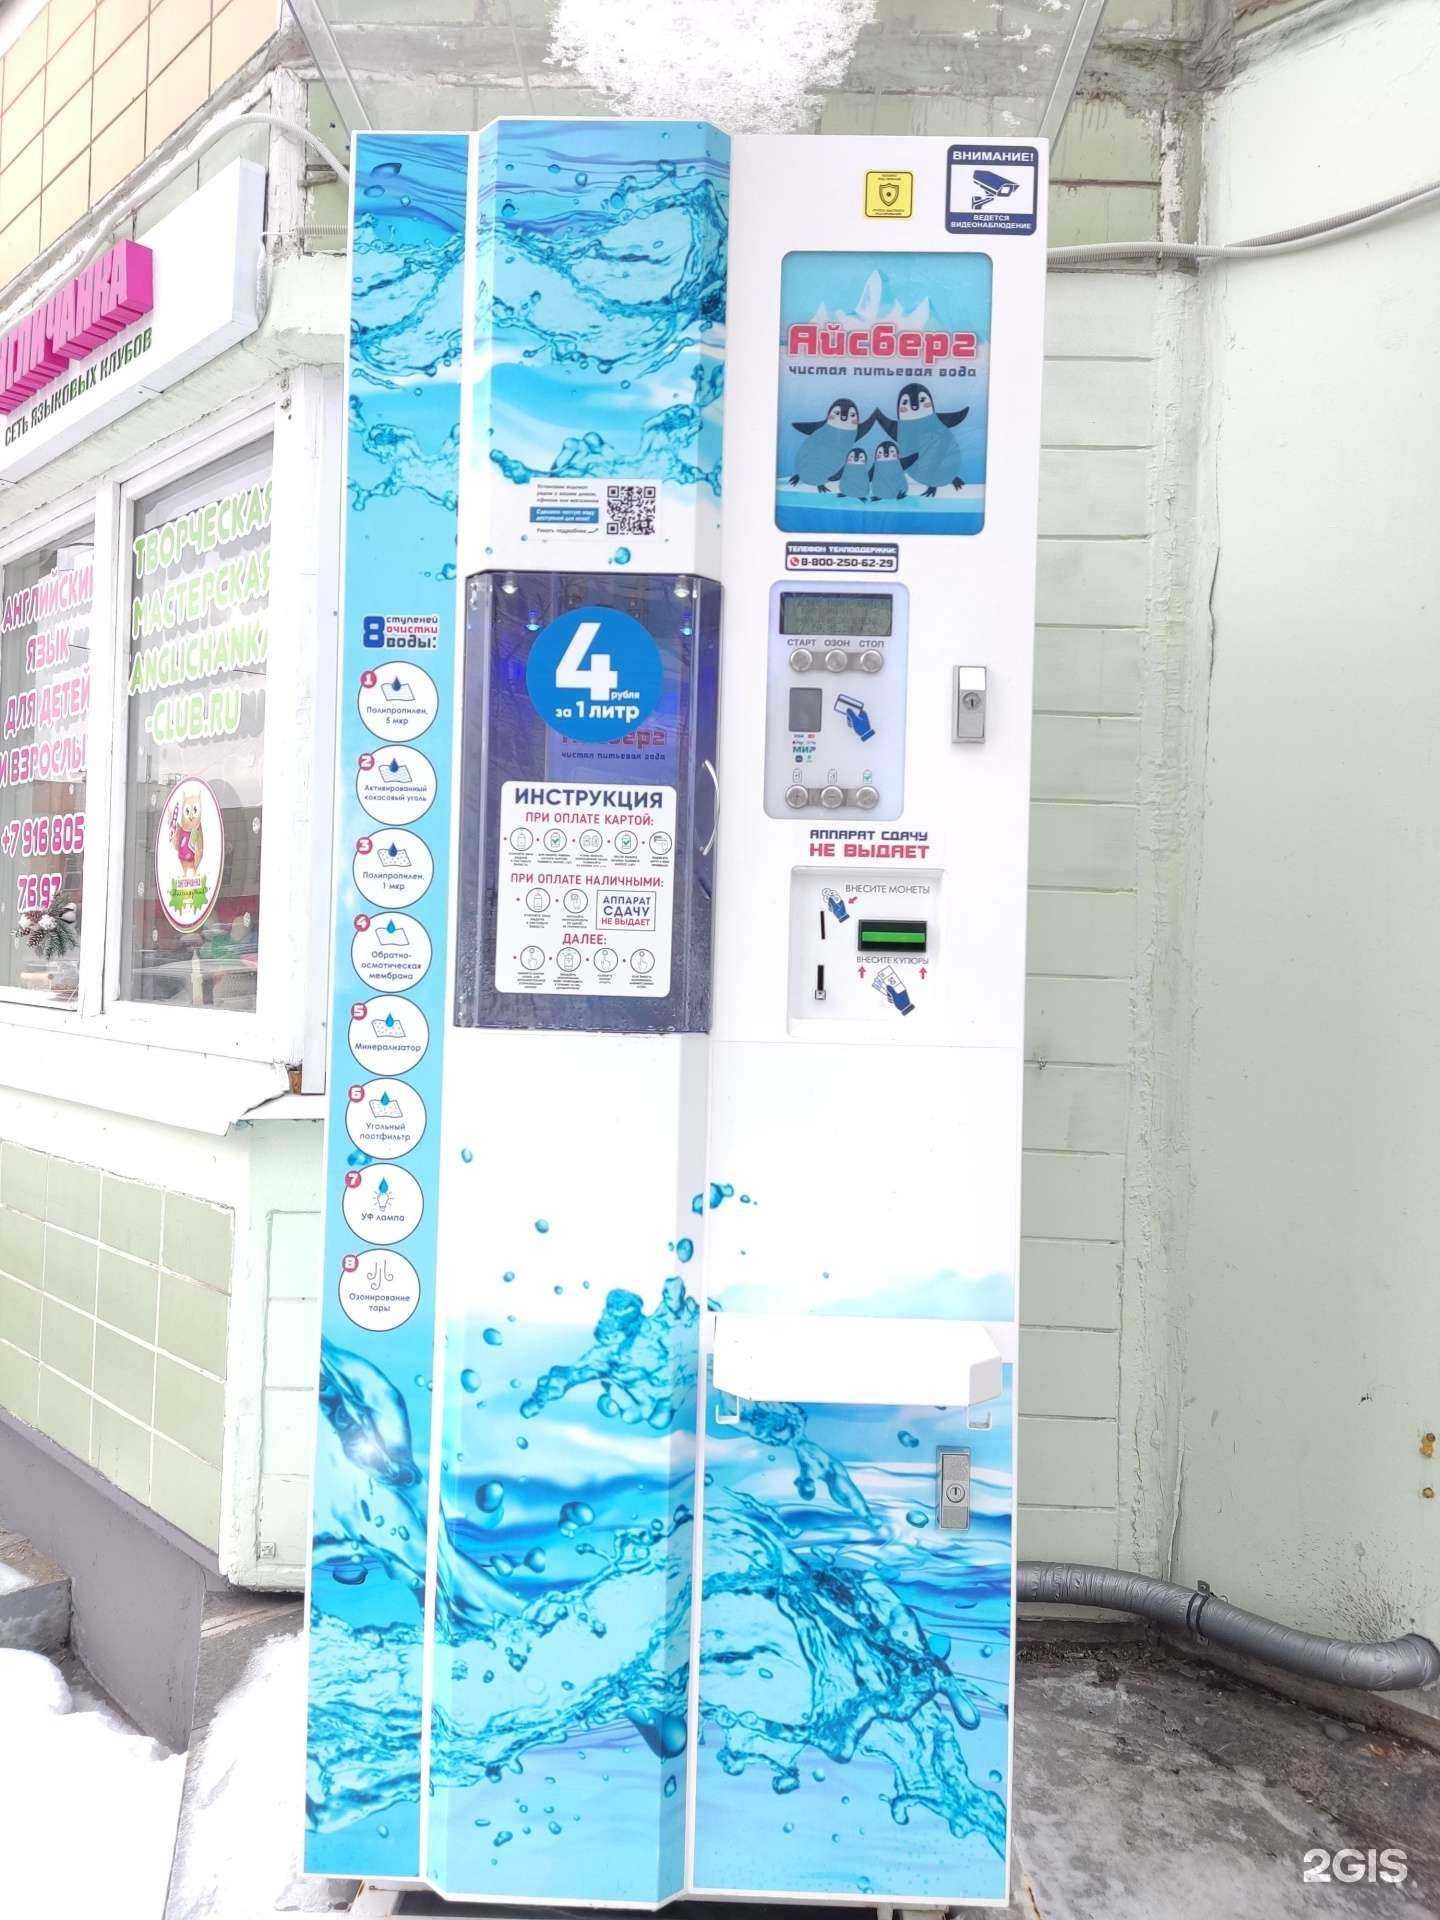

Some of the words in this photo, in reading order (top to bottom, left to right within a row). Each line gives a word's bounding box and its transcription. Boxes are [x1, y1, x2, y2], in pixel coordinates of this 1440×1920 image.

[952, 150, 1035, 162] ВНИМАНИЕ!
[973, 214, 1010, 222] ВЕДЕТСЯ
[950, 221, 1032, 230] ВИДЕОНАБЛЮДЕНИЕ
[788, 323, 977, 365] Айсберг
[788, 365, 847, 376] чистая
[853, 366, 933, 377] питьевая
[939, 365, 977, 377] вода
[5, 415, 29, 447] СЕТЬ
[31, 362, 97, 428] ЯЗЫКОВЫХ
[99, 326, 153, 381] КЛУБОВ
[801, 557, 894, 568] 8-800-250-62-29
[363, 615, 386, 648] 8
[386, 616, 438, 625] ступеней
[386, 625, 438, 634] очистки
[386, 634, 437, 649] воды:
[787, 639, 816, 647] СТАРТ
[824, 639, 851, 647] ОЗОН
[858, 640, 885, 648] СТОП
[26, 621, 71, 675] ЯЗЫК
[555, 622, 618, 701] 4
[610, 690, 640, 700] рубля
[4, 688, 38, 740] ДЛЯ
[38, 663, 91, 732] ДЕТЕЙ
[366, 706, 428, 716] Полипропилен,
[555, 707, 572, 718] за
[575, 701, 585, 718] 1
[589, 705, 640, 723] литр
[792, 746, 816, 754] МИР
[515, 787, 663, 810] ИНСТРУКЦИЯ
[525, 812, 550, 823] ПРИ
[554, 812, 600, 824] ОПЛАТЕ
[604, 813, 655, 826] КАРТОЙ:
[1, 820, 21, 858] +7
[22, 816, 49, 858] 916
[51, 811, 85, 855] 805
[809, 829, 876, 841] АППАРАТ
[881, 830, 928, 842] СДАЧУ
[809, 843, 836, 857] НЕ
[843, 844, 930, 859] ВЫДАЕТ
[362, 871, 425, 881] Полипропилен,
[510, 873, 534, 884] ПРИ
[537, 874, 582, 885] ОПЛАТЕ
[585, 875, 665, 888] НАЛИЧНЫМИ:
[845, 884, 887, 894] ВНЕСИТЕ
[888, 885, 931, 895] МОНЕТЫ
[602, 896, 652, 906] АППАРАТ
[603, 905, 650, 917] СДАЧУ
[601, 918, 614, 926] НЕ
[614, 918, 651, 927] ВЫДАЕТ
[562, 934, 607, 945] ДАЛЕЕ:
[856, 956, 892, 964] ВНЕСИТЕ
[893, 957, 929, 965] КУПЮРЫ
[354, 1043, 422, 1053] Минерализатор
[365, 1122, 406, 1132] Угольный
[361, 1212, 374, 1222] УФ
[375, 1214, 406, 1223] лампа
[349, 1292, 411, 1303] Озонирование
